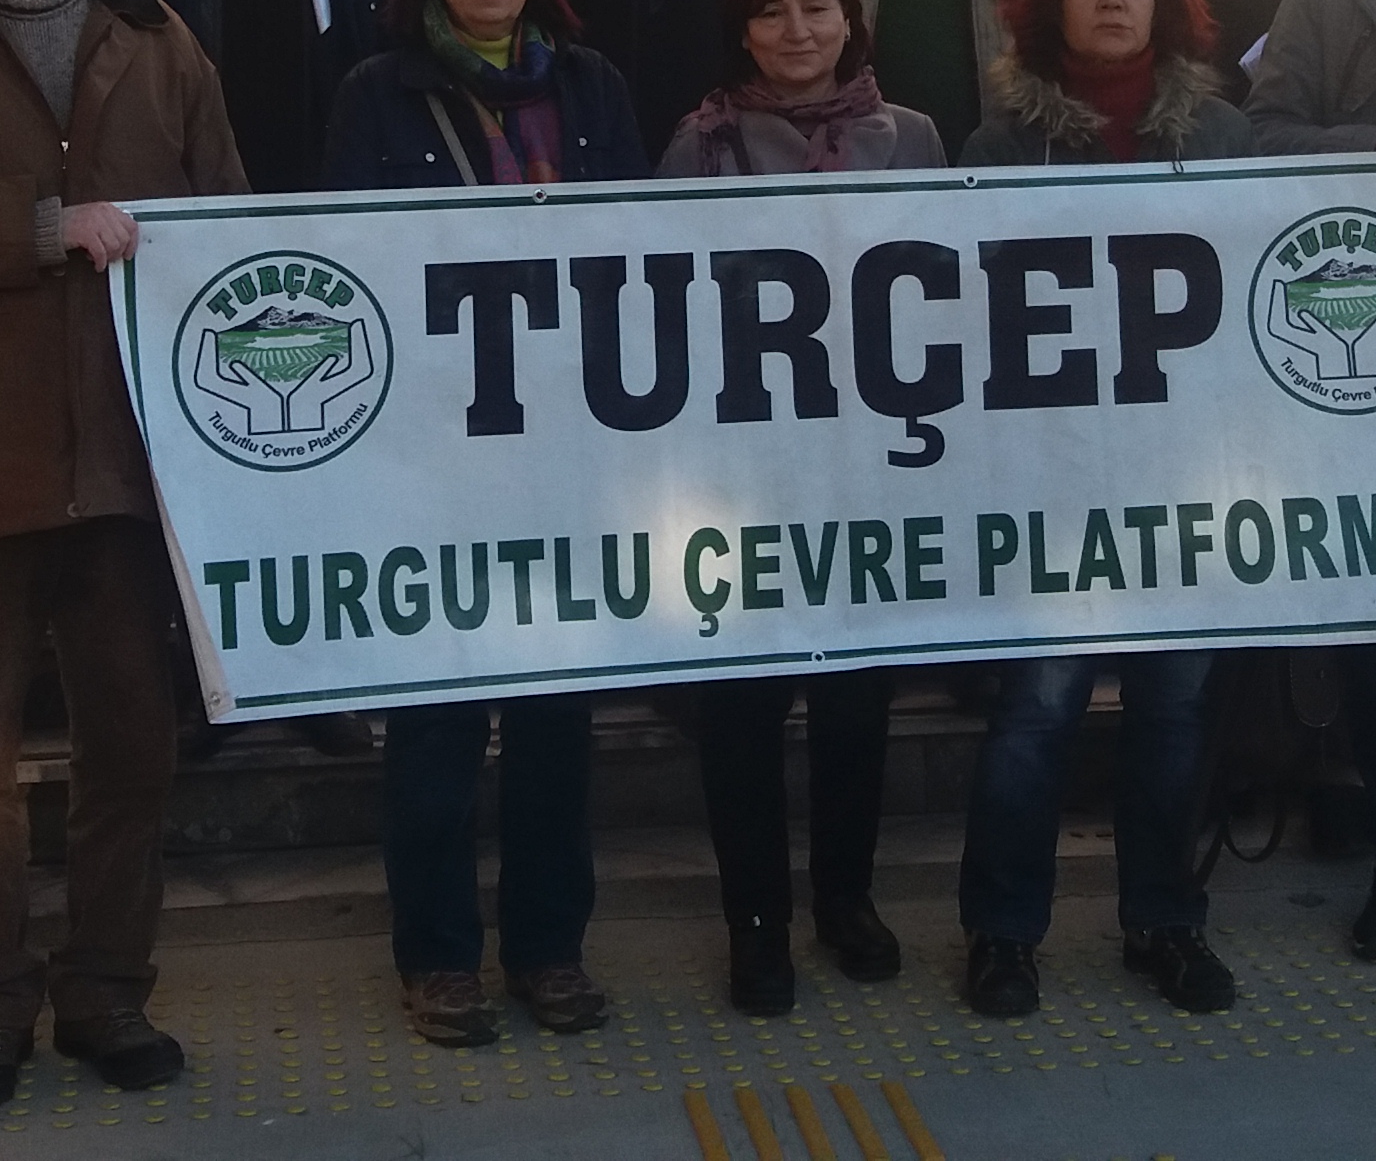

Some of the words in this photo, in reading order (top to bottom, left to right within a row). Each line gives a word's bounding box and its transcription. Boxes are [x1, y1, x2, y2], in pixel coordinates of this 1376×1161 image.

[206, 263, 355, 321] TURÇEP
[424, 232, 1224, 469] TURÇEP
[1280, 356, 1330, 398] Turgutlu
[1331, 387, 1372, 403] Çevre
[207, 410, 259, 454] Turgutlu
[261, 442, 306, 459] Çevre
[307, 402, 369, 453] Platformu
[202, 531, 652, 651] TURGUTLU
[683, 515, 947, 638] ÇEVRE
